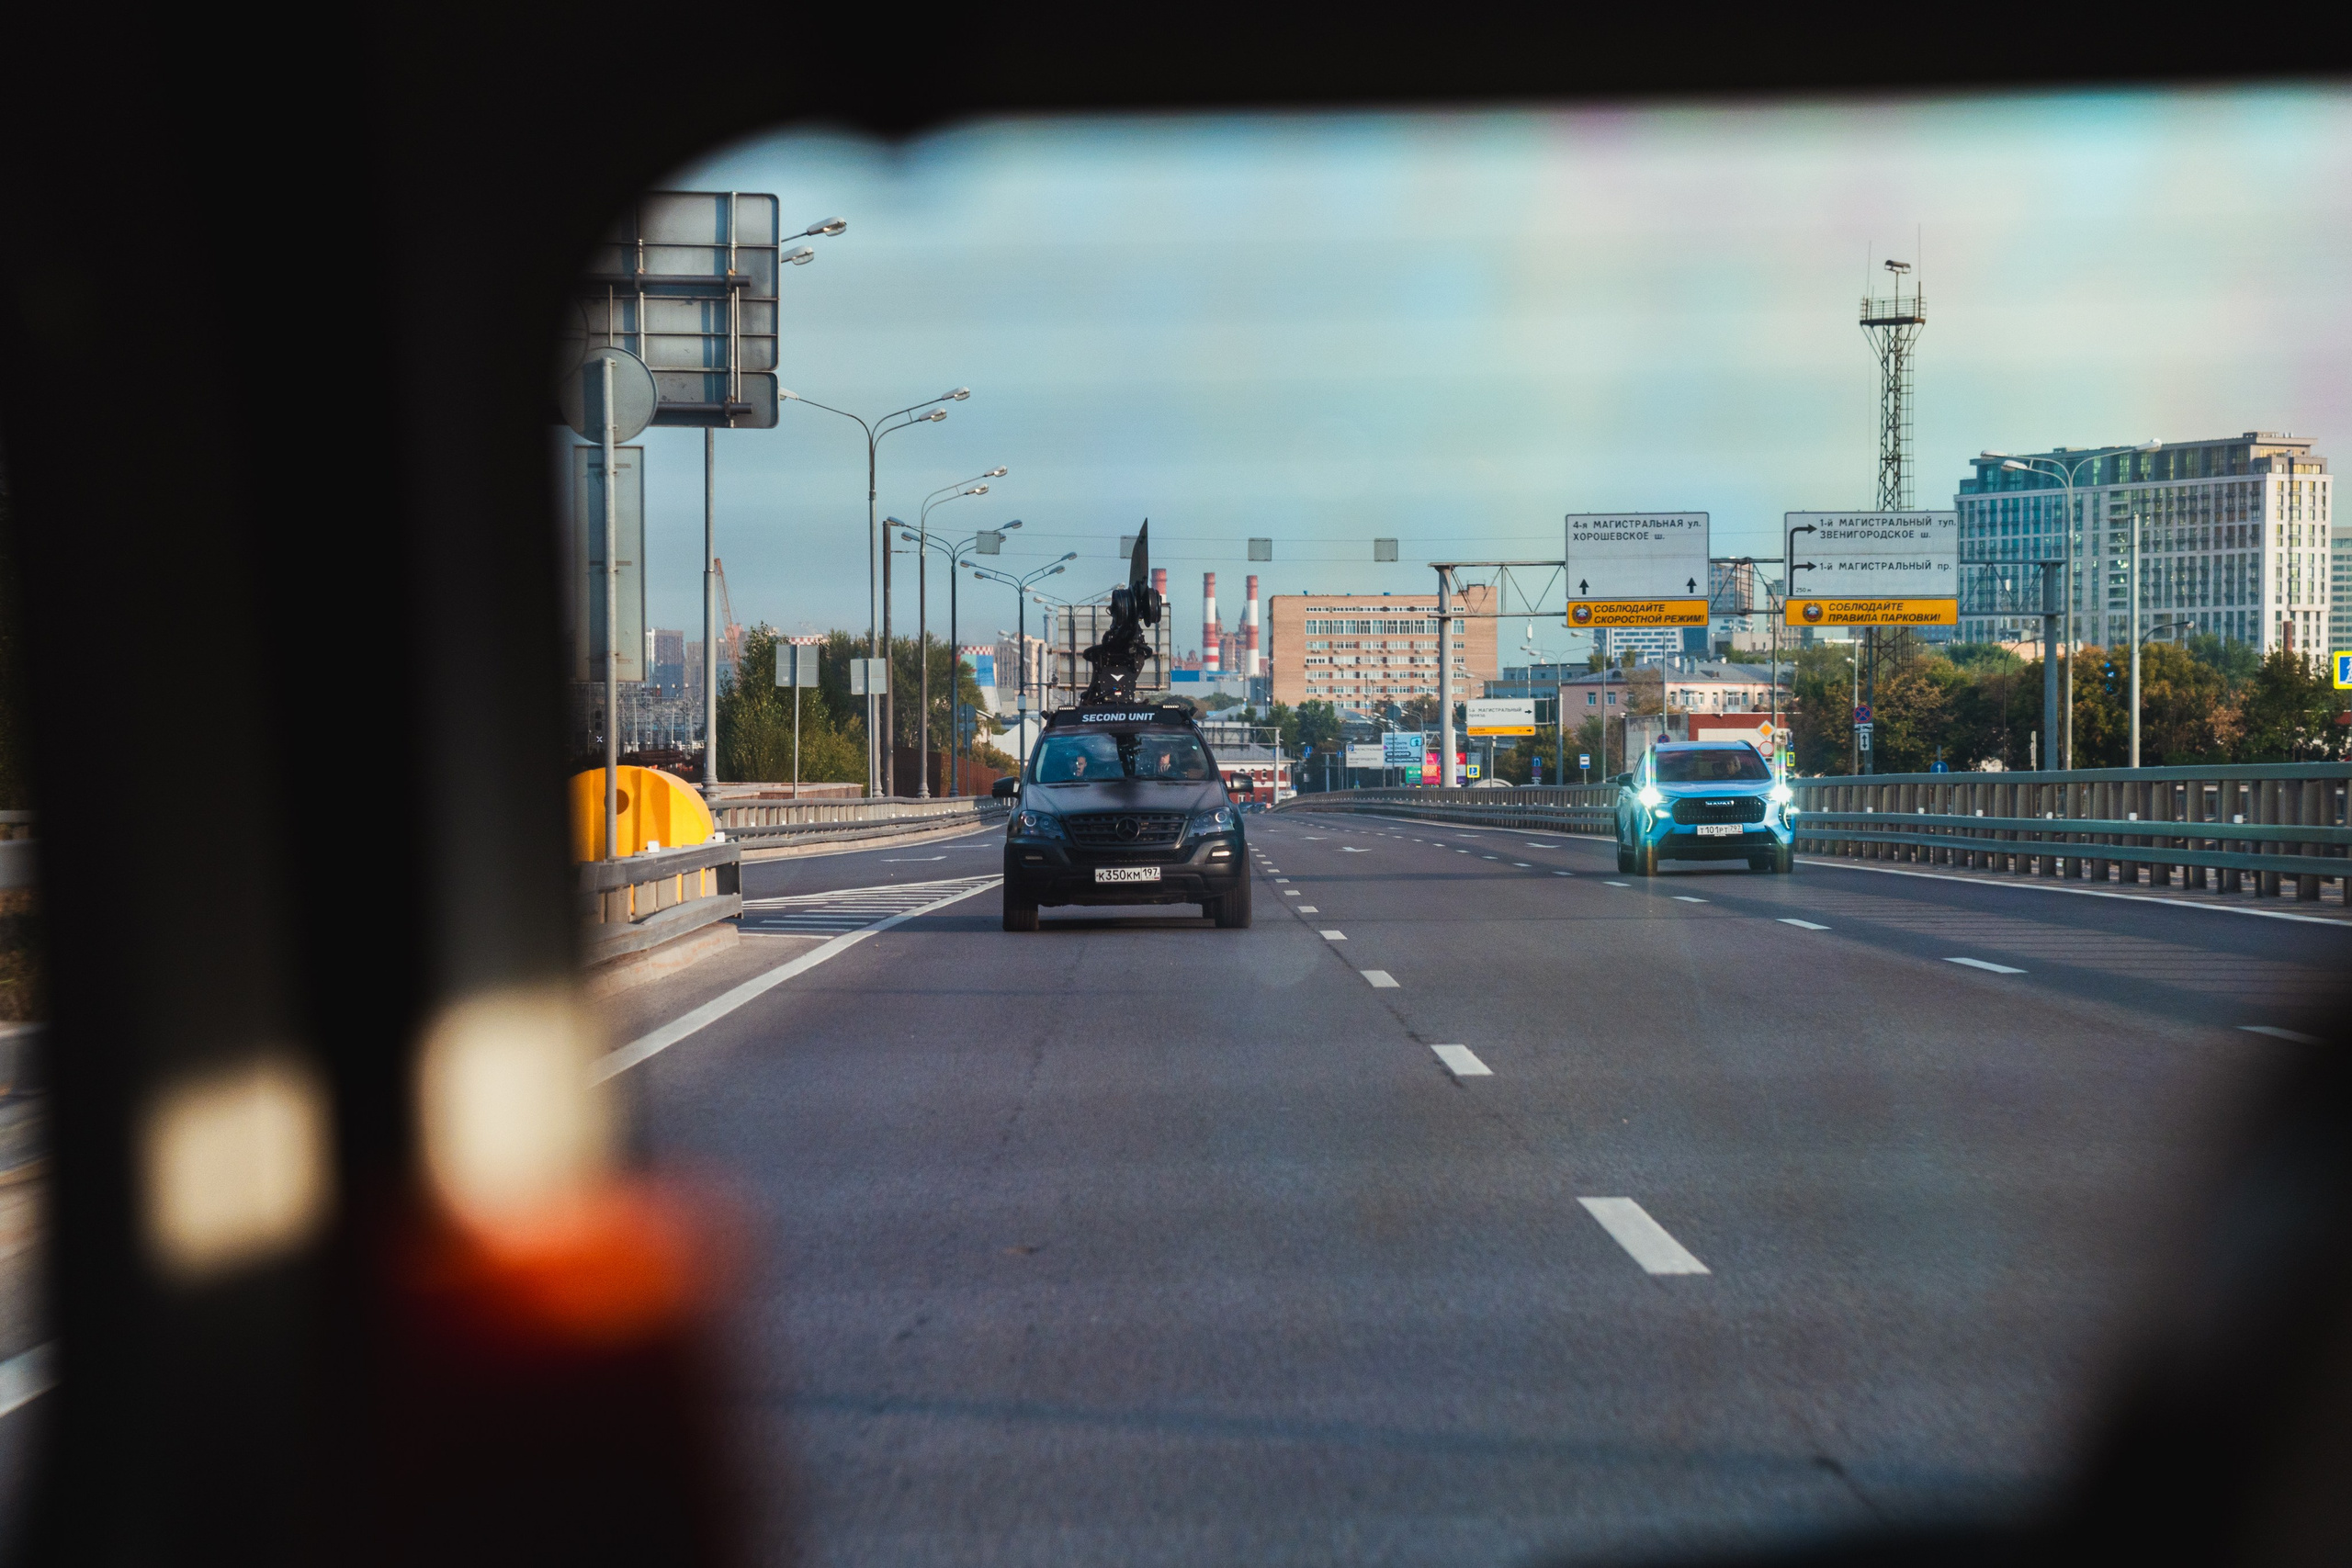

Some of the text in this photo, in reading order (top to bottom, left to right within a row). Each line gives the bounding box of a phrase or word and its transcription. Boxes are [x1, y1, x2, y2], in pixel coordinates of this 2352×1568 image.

[1573, 519, 1702, 530] 4-я МАГИСТРАЛЬНАЯ ул.
[1820, 515, 1957, 528] 1-й МАГИСТРАЛЬНЫЙ туп.
[1573, 532, 1649, 541] ХОРОШЕВСКОЕ
[1820, 530, 1915, 539] ЗВЕНИГОРОДСКОЕ
[1820, 559, 1952, 572] 1-й МАГИСТРАЛЬНЫЙ пр.
[1594, 604, 1666, 614] СОБЛЮДАЙТЕ
[1828, 602, 1904, 612] СОБЛЮДАЙТЕ
[1594, 614, 1704, 625] СКОРОСТНОЙ РЕЖИМ!
[1827, 613, 1940, 622] ПРАВИЛА ПАРКОВКИ!
[1081, 712, 1156, 722] SECOND UNIT
[1142, 868, 1158, 876] 197
